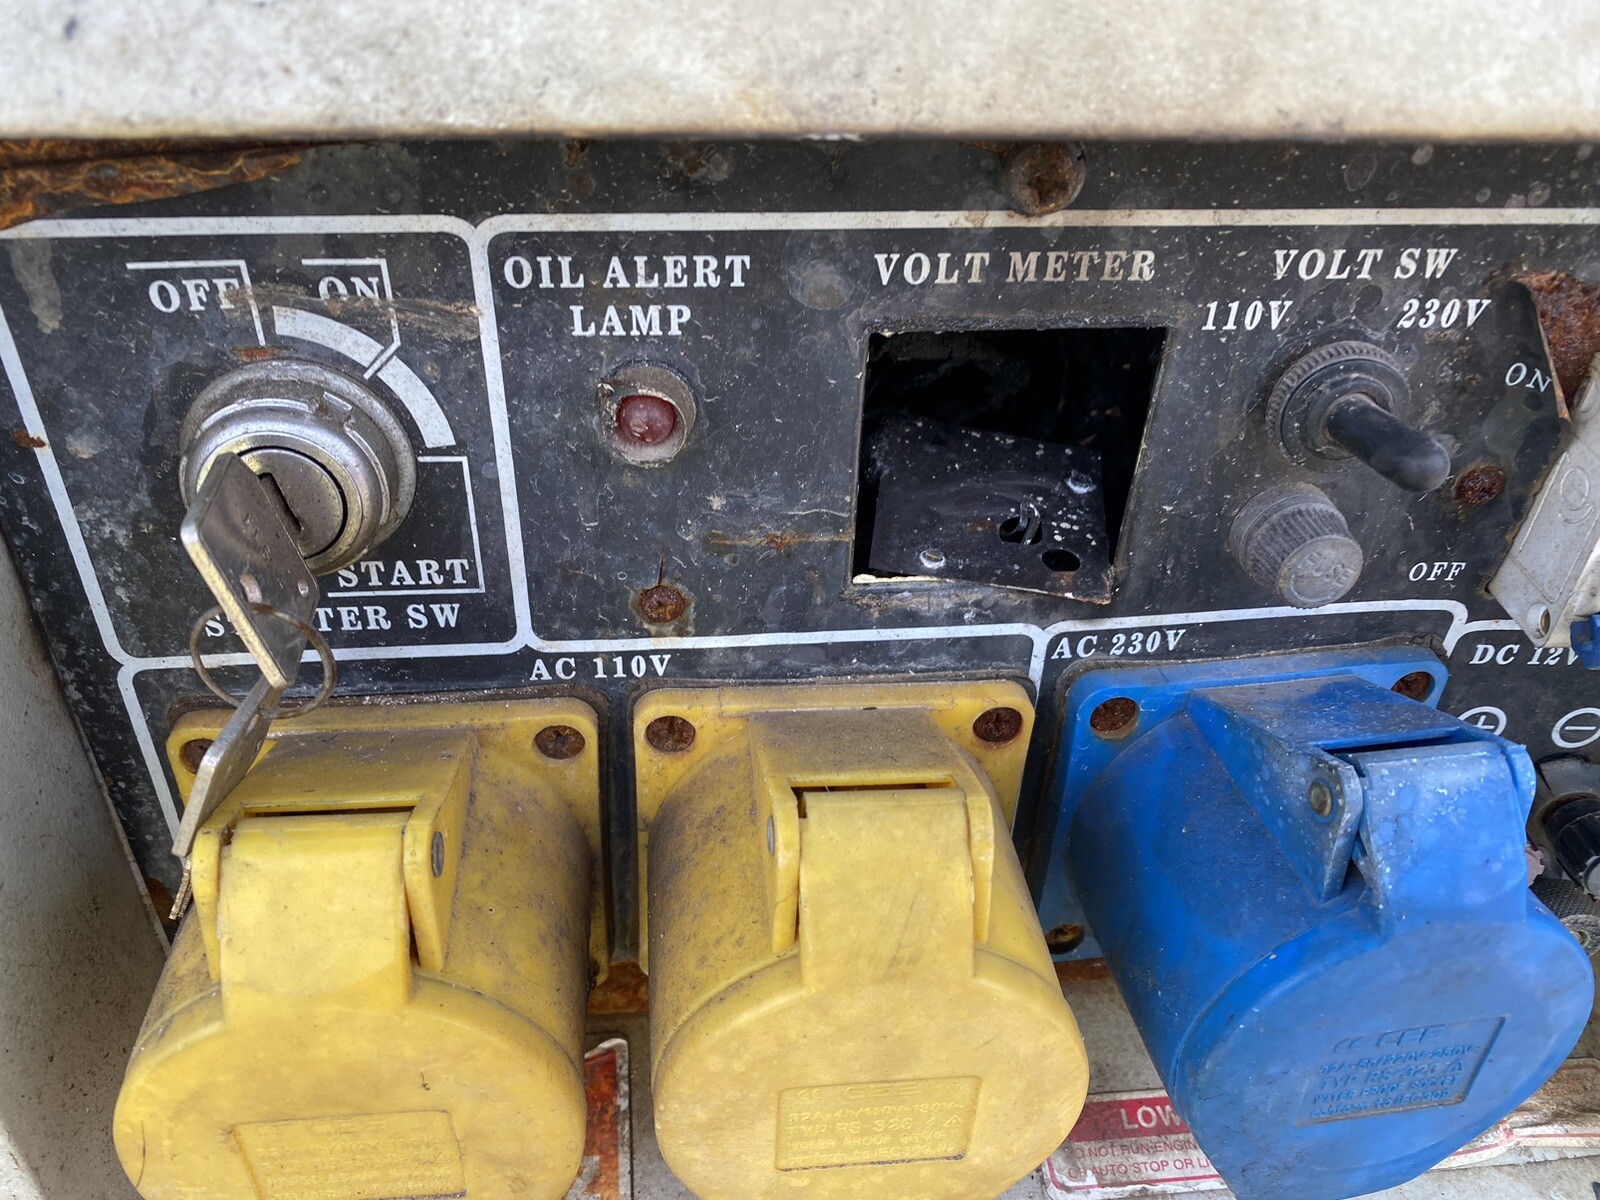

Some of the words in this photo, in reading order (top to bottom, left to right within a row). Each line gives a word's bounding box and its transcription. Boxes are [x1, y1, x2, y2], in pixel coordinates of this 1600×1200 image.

[503, 255, 585, 289] OIL
[603, 254, 751, 288] ALERT
[873, 252, 990, 286] VOLT
[1005, 250, 1157, 283] METER
[1273, 248, 1385, 281] VOLT
[1393, 247, 1459, 280] SW
[149, 277, 240, 314] OFF
[318, 276, 380, 306] ON
[569, 304, 692, 337] LAMP
[1201, 300, 1293, 331] 110V
[1397, 298, 1492, 329] 230V
[1505, 362, 1552, 393] ON
[337, 558, 470, 588] START
[1408, 561, 1467, 582] OFF
[204, 606, 392, 638] STER
[406, 603, 461, 630] SW
[1050, 634, 1098, 660] AC
[1109, 628, 1187, 656] 230V
[1468, 643, 1521, 666] DC
[529, 657, 577, 681] AC
[593, 653, 672, 679] 110V
[1120, 1105, 1181, 1130] LOW
[1087, 1142, 1118, 1157] NOT
[1155, 1139, 1198, 1153] ENGIN
[1091, 1162, 1128, 1177] AUTO
[1132, 1158, 1169, 1174] STOP
[1173, 1157, 1195, 1171] OR
